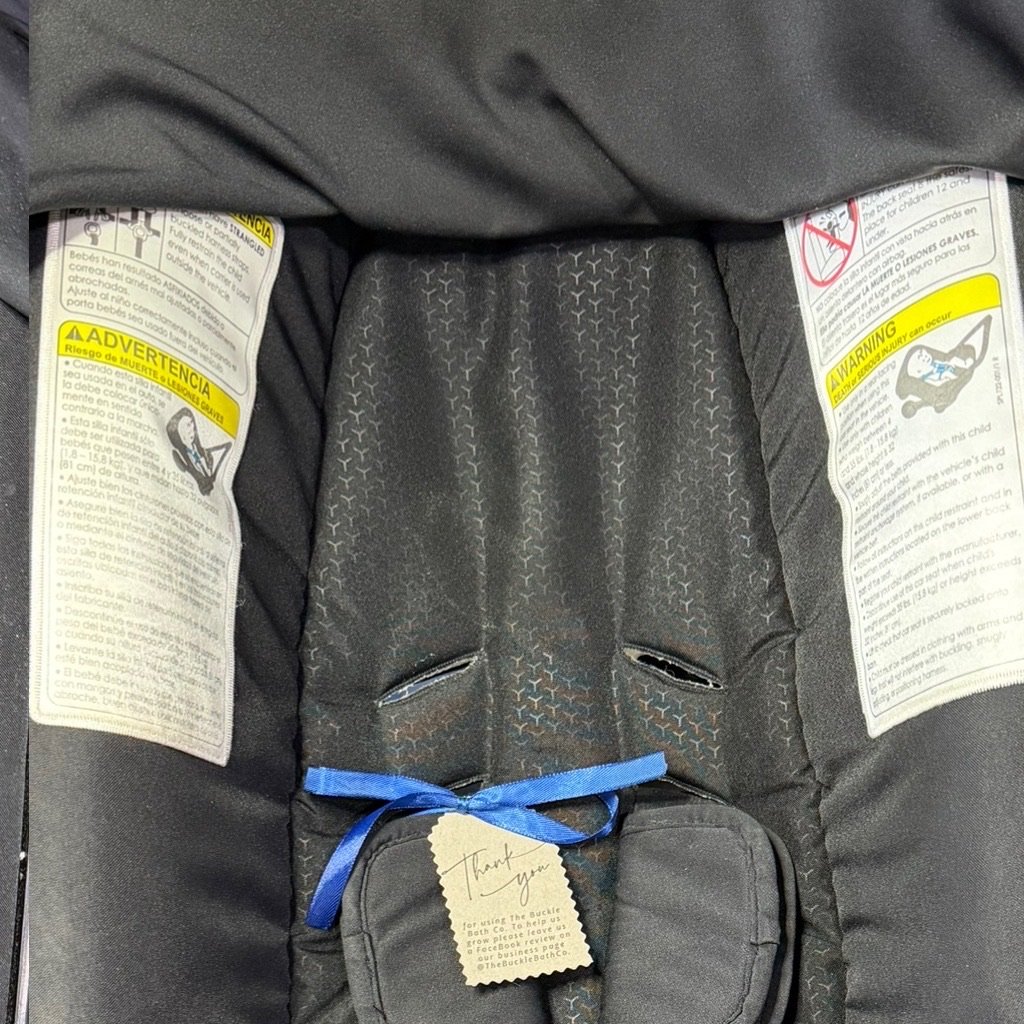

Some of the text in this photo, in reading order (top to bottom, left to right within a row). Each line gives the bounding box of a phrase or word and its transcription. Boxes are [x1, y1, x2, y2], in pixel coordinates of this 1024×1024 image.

[866, 176, 970, 236] place children and
[230, 224, 265, 256] STRANGLED
[914, 220, 938, 240] hacia
[70, 250, 162, 284] Bebés han resultado
[870, 228, 980, 289] MUERTE LESIONES GRAVES.
[68, 274, 130, 296] abrochadas.
[132, 301, 188, 337] correctamente
[836, 320, 896, 382] WARNING
[856, 311, 952, 380] SERIOUS INJURY can occur
[72, 360, 113, 376] Cuando
[86, 328, 211, 400] ADVERTENCIA
[64, 344, 224, 424] Riesgo de MUERTE LESIONES GRAVES
[968, 422, 992, 438] child
[940, 446, 1006, 477] vehicle's child
[441, 843, 546, 900] Thank
[480, 863, 550, 907] you
[463, 907, 560, 931] for using The Buckle
[467, 928, 489, 938] Bath
[493, 926, 508, 934] Co.
[512, 922, 522, 930] To
[526, 918, 546, 928] help
[467, 938, 490, 948] grow
[493, 932, 524, 944] please
[528, 926, 552, 936] leave
[476, 941, 521, 954] FaceBook
[524, 934, 556, 944] review
[478, 942, 565, 962] our business page
